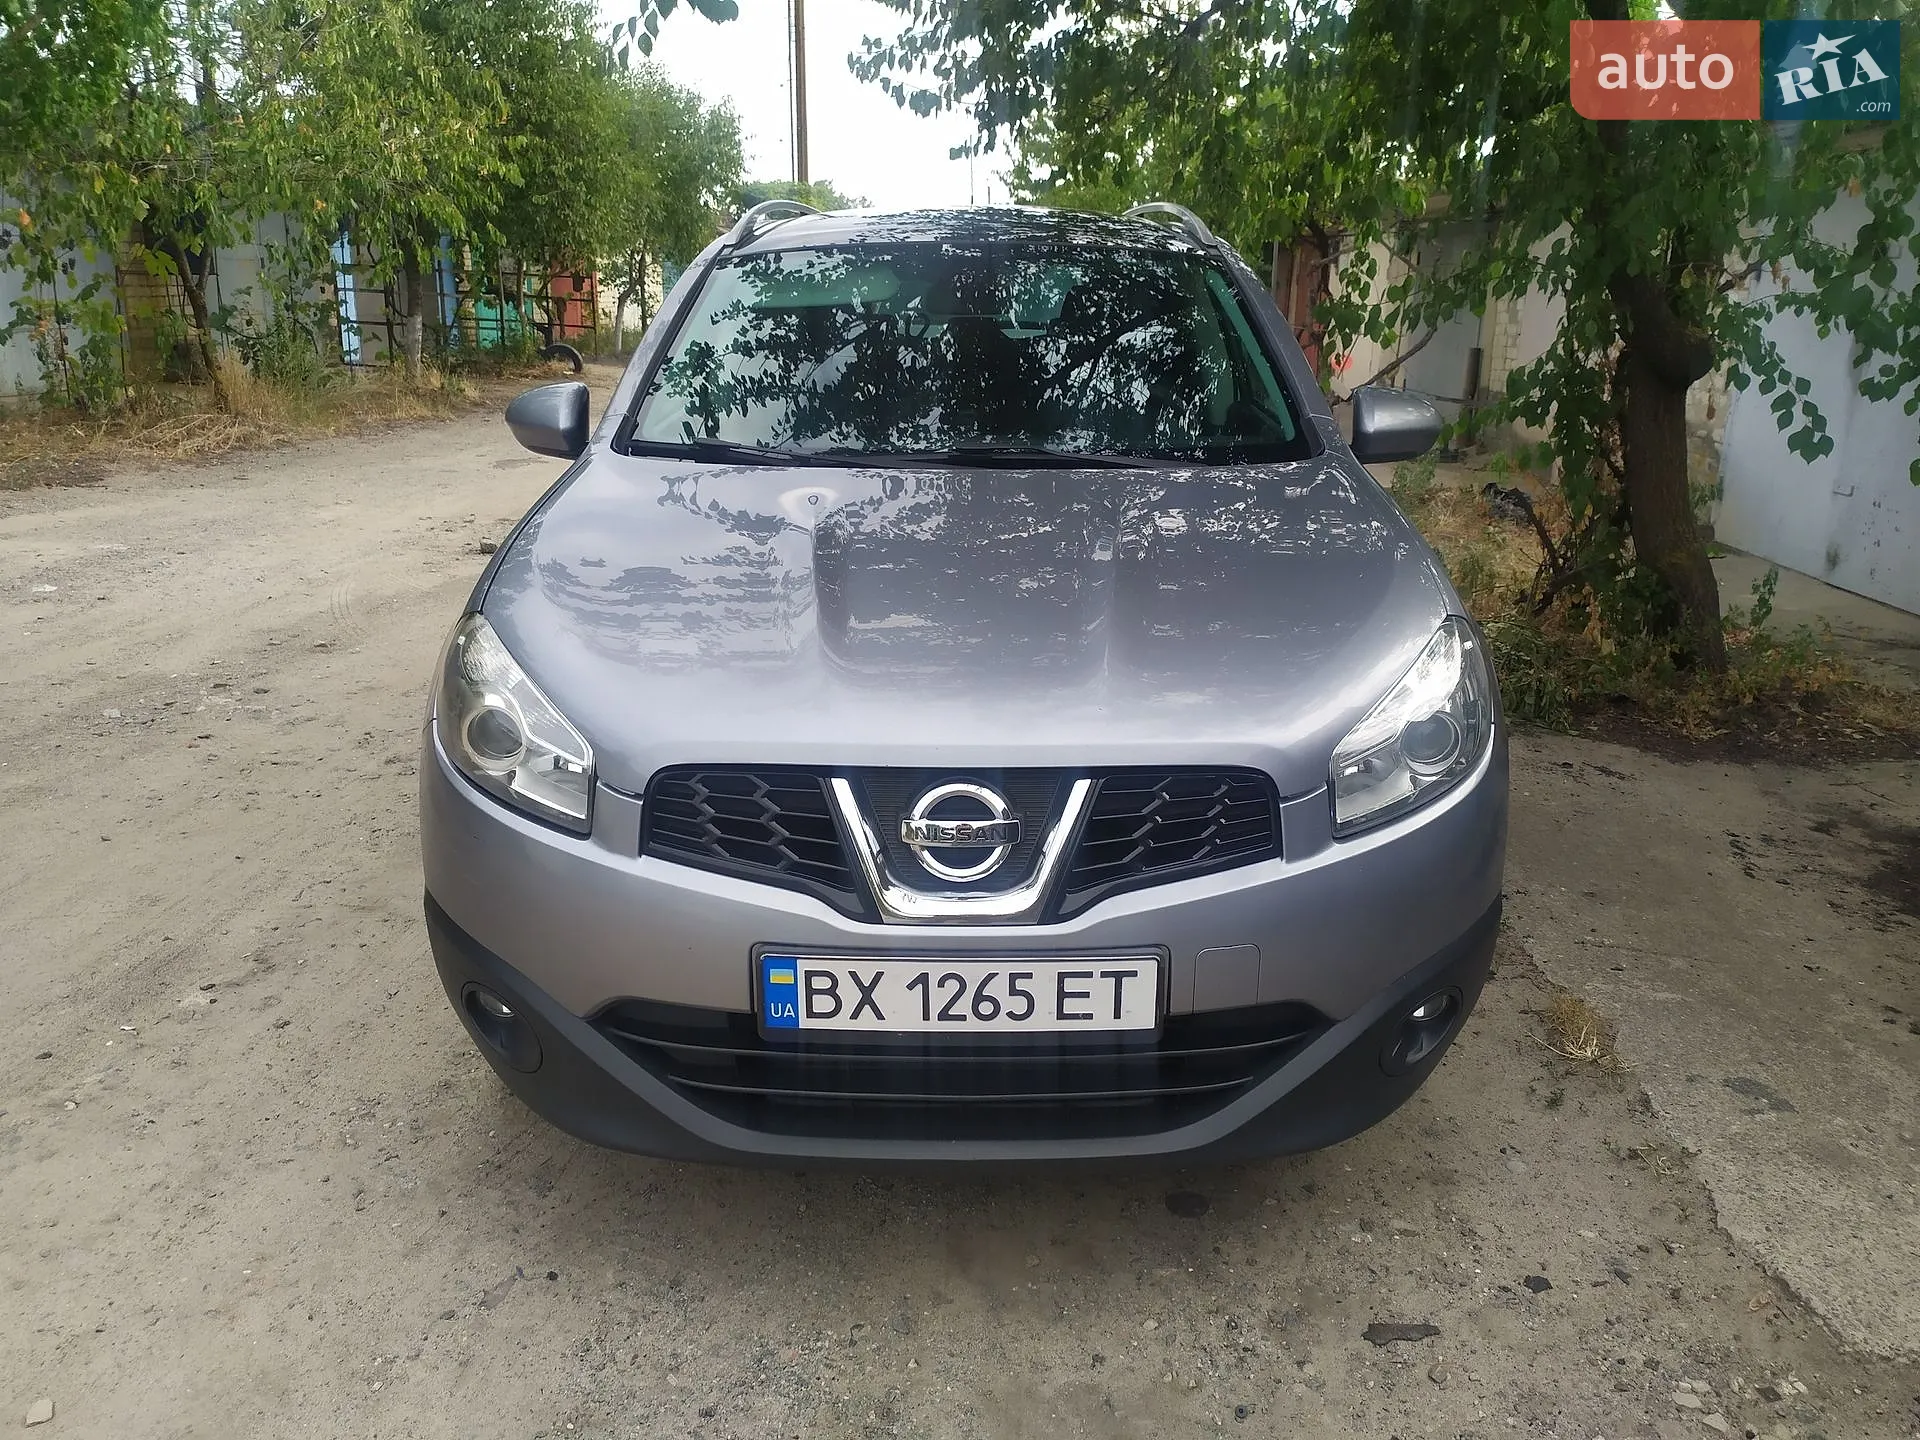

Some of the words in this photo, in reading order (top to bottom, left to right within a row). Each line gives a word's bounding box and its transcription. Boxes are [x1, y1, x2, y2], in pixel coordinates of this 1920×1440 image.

[914, 823, 1009, 843] NISSAN
[804, 969, 886, 1021] BX
[905, 971, 1035, 1022] 1265
[1056, 970, 1138, 1021] ET
[770, 1002, 796, 1018] UA
